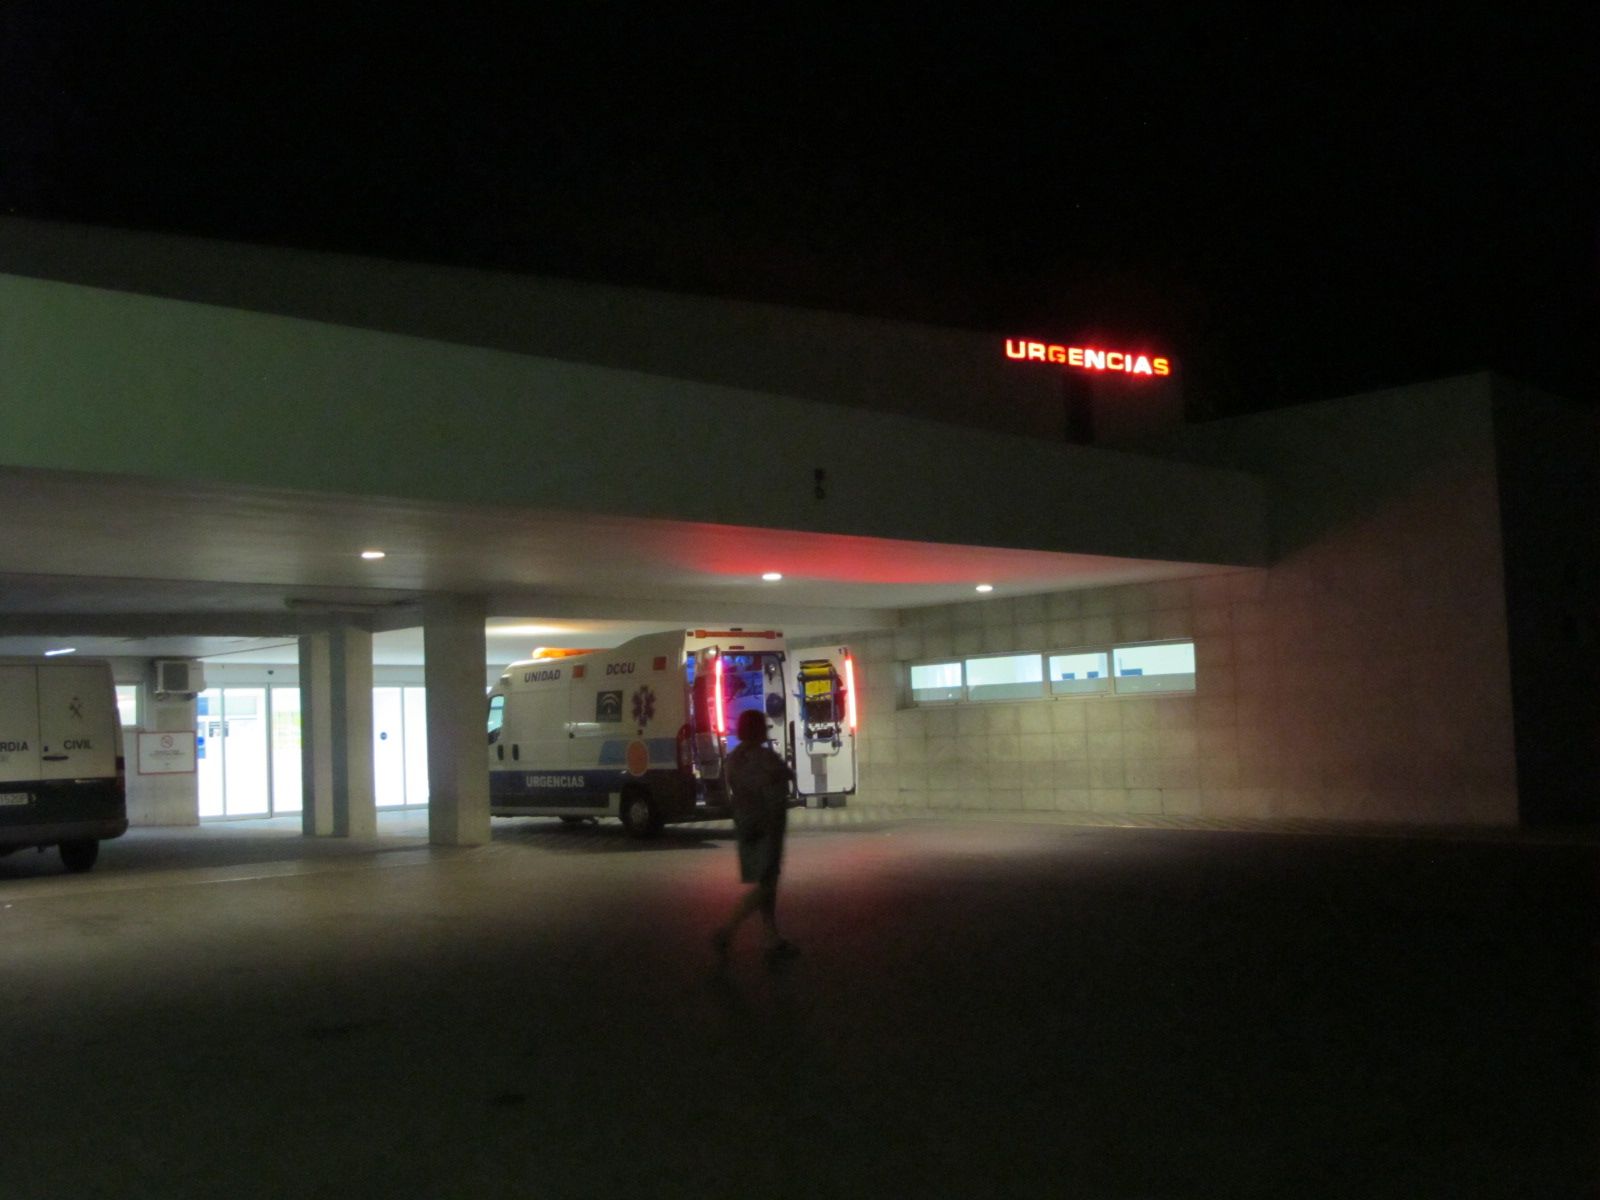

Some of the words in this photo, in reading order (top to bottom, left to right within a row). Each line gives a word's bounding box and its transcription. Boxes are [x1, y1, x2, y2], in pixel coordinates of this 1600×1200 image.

[1006, 339, 1169, 375] URGENCIAS
[524, 670, 560, 682] UNIDAD
[606, 662, 635, 675] DCCU
[64, 739, 92, 750] CIVIL
[526, 775, 585, 787] URGENCIAS
